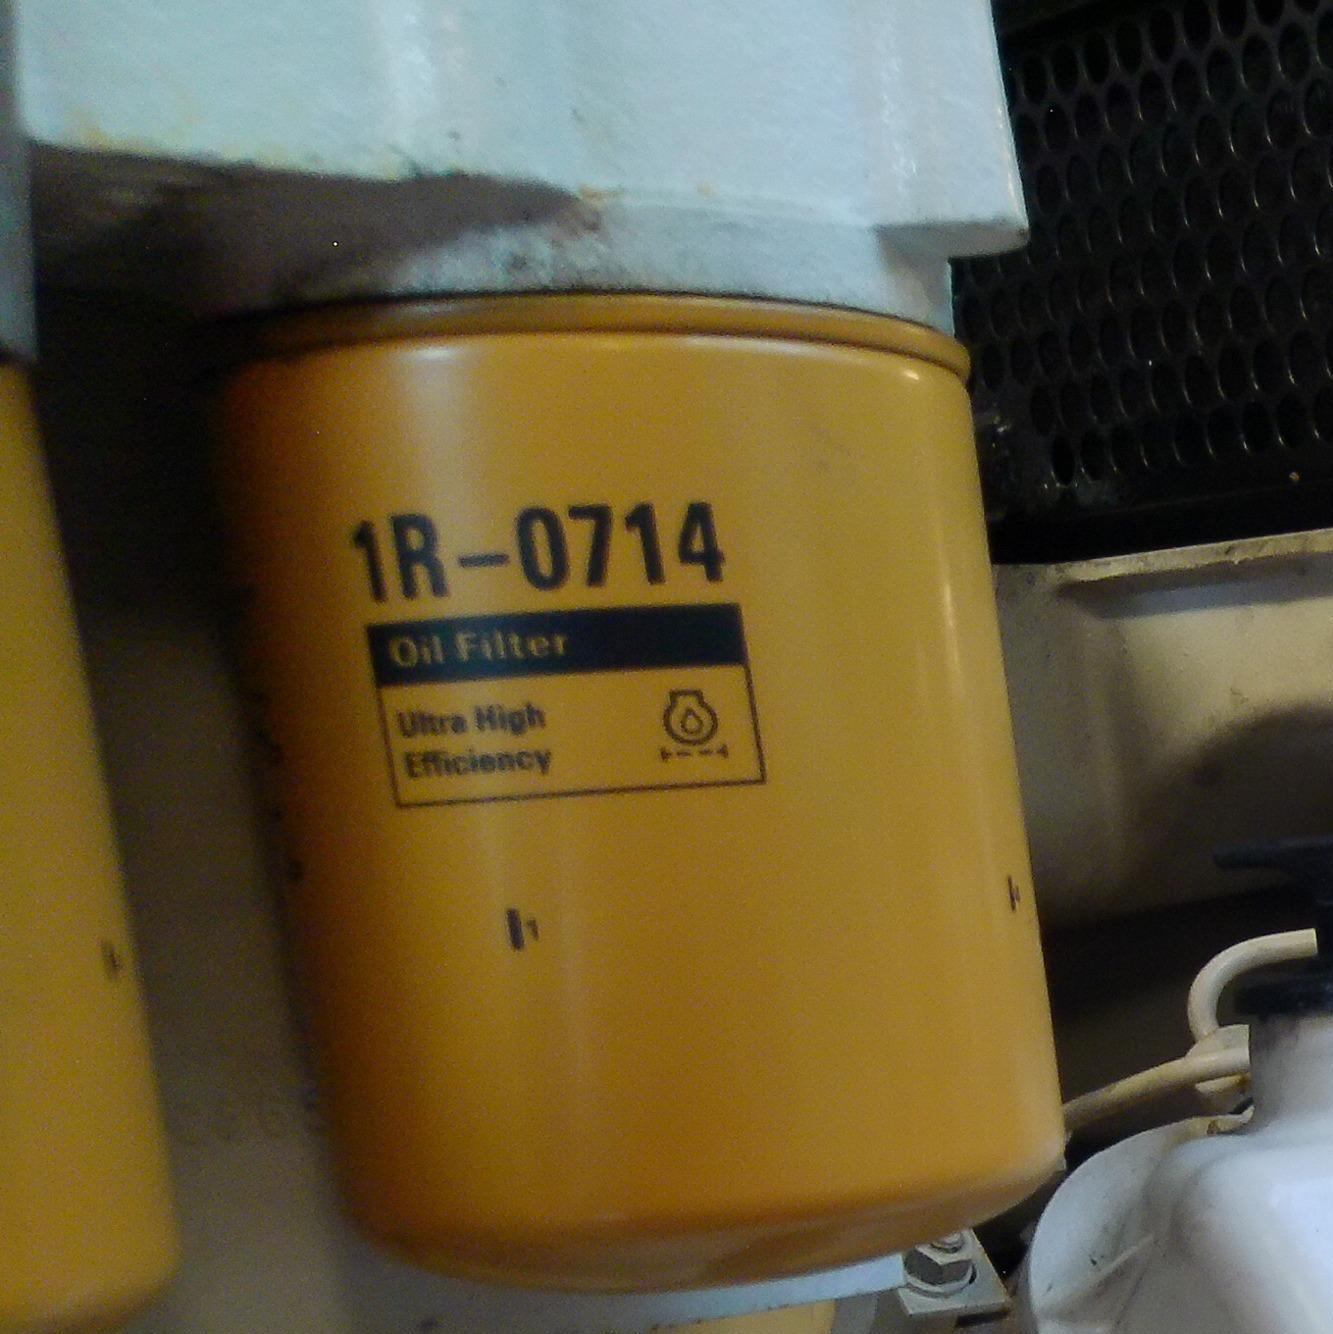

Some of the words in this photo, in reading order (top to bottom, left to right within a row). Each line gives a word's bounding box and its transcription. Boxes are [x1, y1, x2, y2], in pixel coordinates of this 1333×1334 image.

[351, 502, 726, 602] 1R-0714
[389, 631, 443, 669] Oil
[456, 628, 570, 664] Filter
[400, 706, 468, 741] Ultra
[475, 702, 546, 737] High
[404, 746, 553, 781] Efficiency
